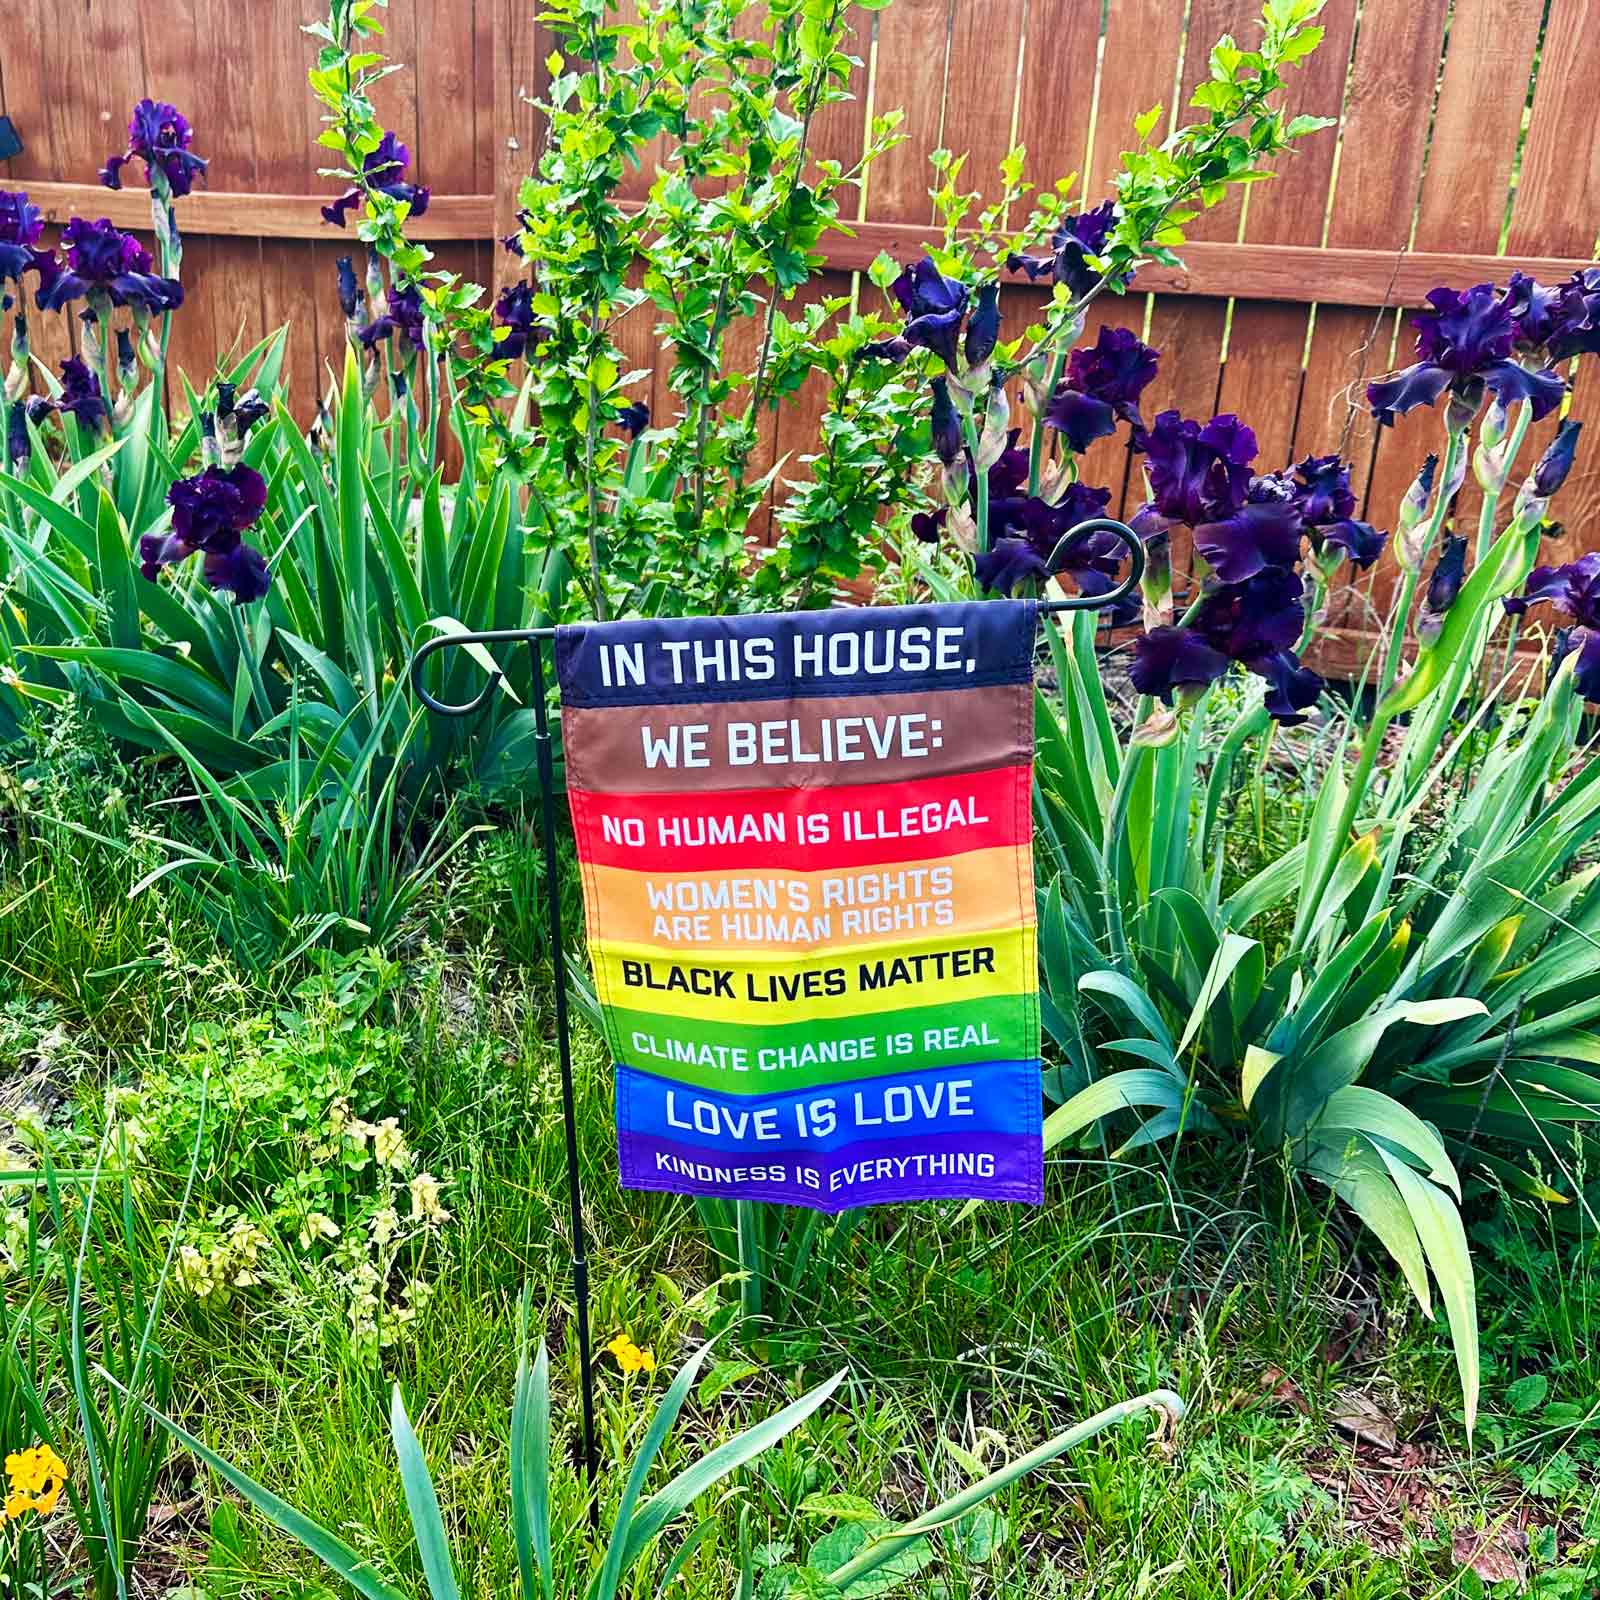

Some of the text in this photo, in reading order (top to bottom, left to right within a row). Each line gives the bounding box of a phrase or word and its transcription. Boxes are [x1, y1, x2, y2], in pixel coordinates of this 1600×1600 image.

[599, 626, 976, 687] IN THIS HOUSE,
[640, 713, 943, 769] WE BELIEVE:
[602, 796, 989, 847] NO HUMAN IS ILLEGAL
[645, 866, 953, 912] WOMEN'S RIGHTS
[651, 900, 954, 943] ARE HUMAN RIGHTS
[622, 947, 996, 1002] BLACK LIVES MATTER
[631, 1023, 999, 1072] CLIMATE CHANGE IS REAL
[666, 1079, 975, 1140] LOVE IS LOVE
[655, 1152, 996, 1193] KINDNESS IS EVERYTHING
